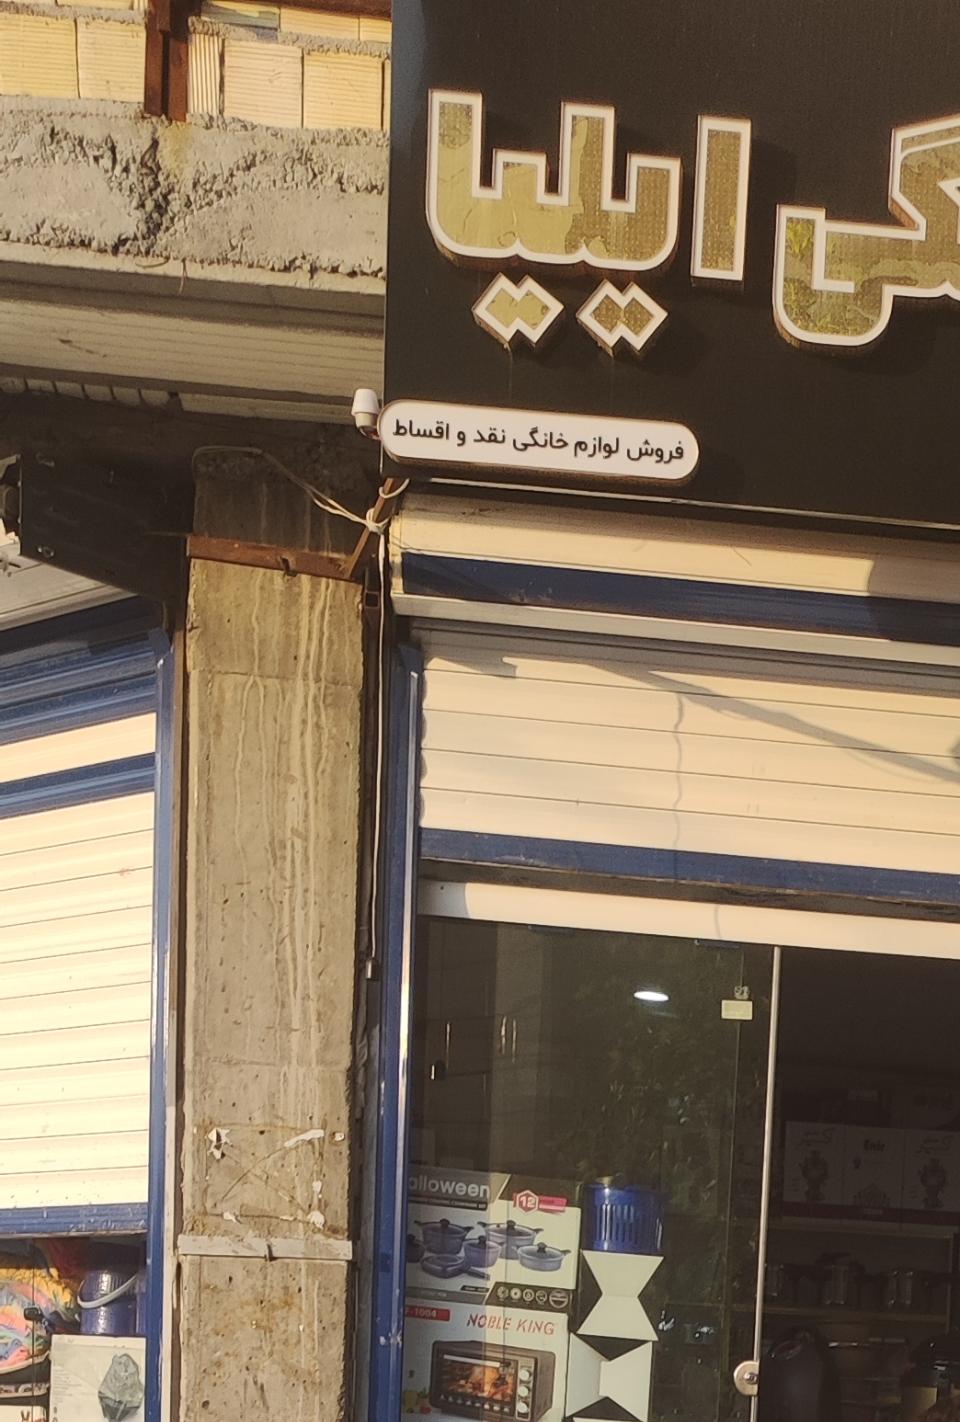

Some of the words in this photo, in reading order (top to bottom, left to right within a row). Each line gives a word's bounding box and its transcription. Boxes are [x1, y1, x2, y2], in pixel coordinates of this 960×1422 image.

[426, 89, 752, 351] ایلیا
[392, 419, 450, 440] اقساط
[456, 431, 466, 446] و
[473, 427, 506, 444] نقد
[512, 426, 568, 451] خانگی
[573, 436, 620, 459] لوازم
[626, 439, 684, 463] فروش
[408, 1174, 490, 1199] alloween
[519, 1195, 536, 1208] 12
[466, 1313, 513, 1330] NOBLE
[516, 1319, 556, 1336] KING
